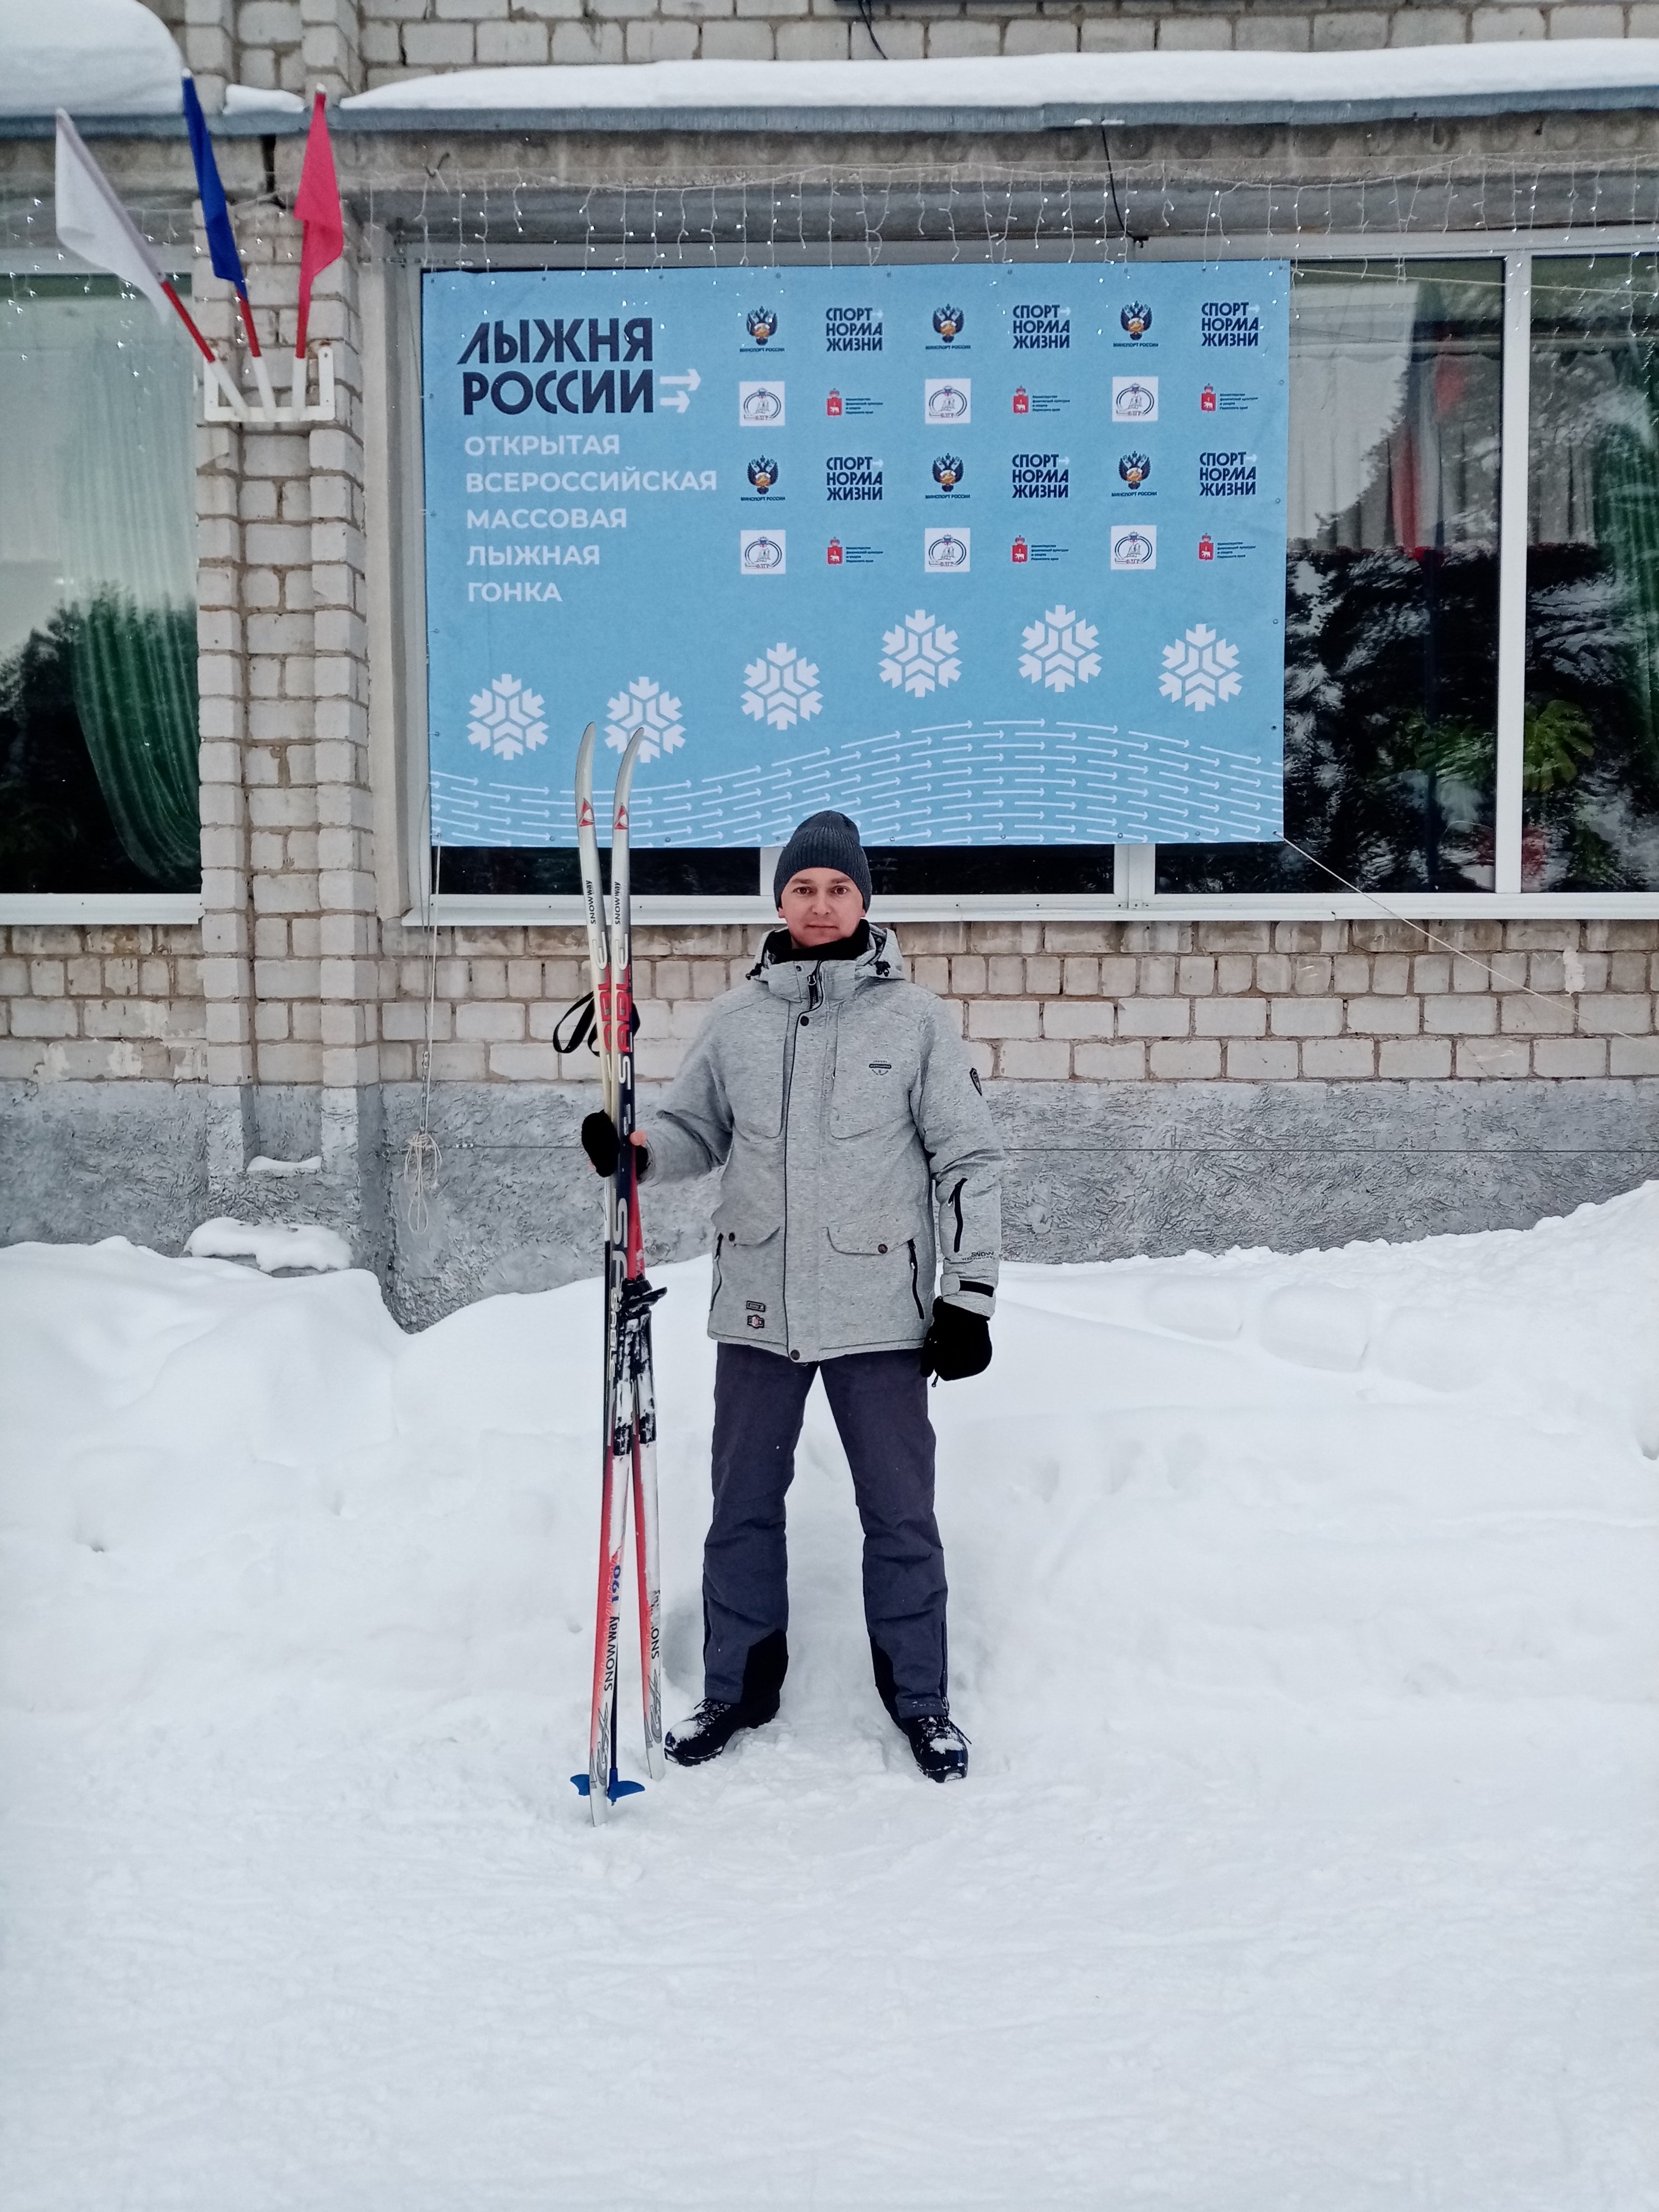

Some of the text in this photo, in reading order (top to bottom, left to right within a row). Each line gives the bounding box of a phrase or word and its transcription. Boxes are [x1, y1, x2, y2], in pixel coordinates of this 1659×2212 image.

[826, 307, 873, 321] СПОРТ
[1013, 305, 1060, 319] СПОРТ
[1201, 301, 1249, 316] СПОРТ
[826, 322, 882, 336] НОРМА
[1013, 320, 1070, 333] НОРМА
[1201, 317, 1259, 331] НОРМА
[457, 317, 653, 365] ЛЫЖНЯ
[826, 337, 882, 351] ЖИЗНИ
[1013, 334, 1070, 349] ЖИЗНИ
[1201, 332, 1259, 347] ЖИЗНИ
[463, 369, 653, 415] РОССИИ
[465, 434, 619, 456] ОТКРЫТАЯ
[826, 456, 873, 470] СПОРТ
[1012, 454, 1059, 467] СПОРТ
[1200, 451, 1246, 466] СПОРТ
[466, 466, 717, 492] ВСЕРОССИЙСКАЯ
[826, 472, 883, 485] НОРМА
[1012, 469, 1069, 483] НОРМА
[1200, 467, 1256, 481] НОРМА
[826, 487, 883, 501] ЖИЗНИ
[1012, 484, 1069, 498] ЖИЗНИ
[1200, 481, 1256, 497] ЖИЗНИ
[467, 508, 627, 529] МАССОВАЯ
[466, 545, 600, 566] ЛЫЖНАЯ
[468, 582, 563, 602] ГОНКА
[608, 1288, 617, 1381] SABLE
[611, 1565, 621, 1603] 190
